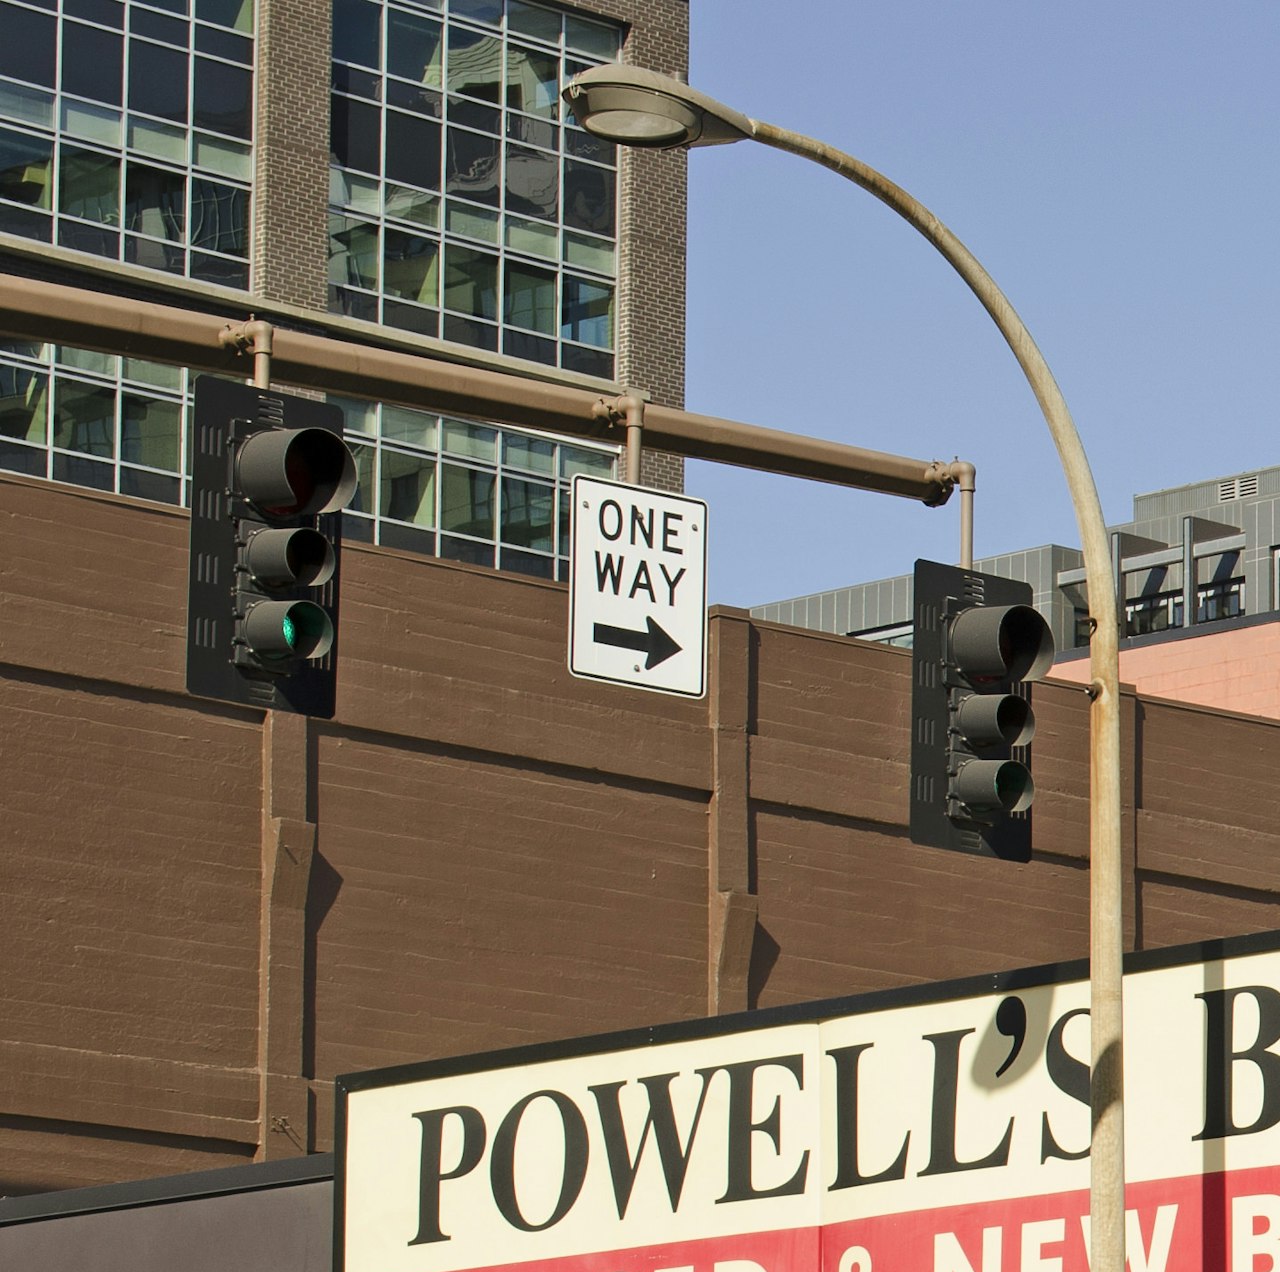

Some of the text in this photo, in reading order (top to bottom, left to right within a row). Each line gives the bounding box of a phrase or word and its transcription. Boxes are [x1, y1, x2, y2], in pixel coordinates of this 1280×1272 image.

[599, 499, 683, 555] ONE
[595, 550, 687, 607] WAY
[408, 996, 1091, 1247] POWELL'S
